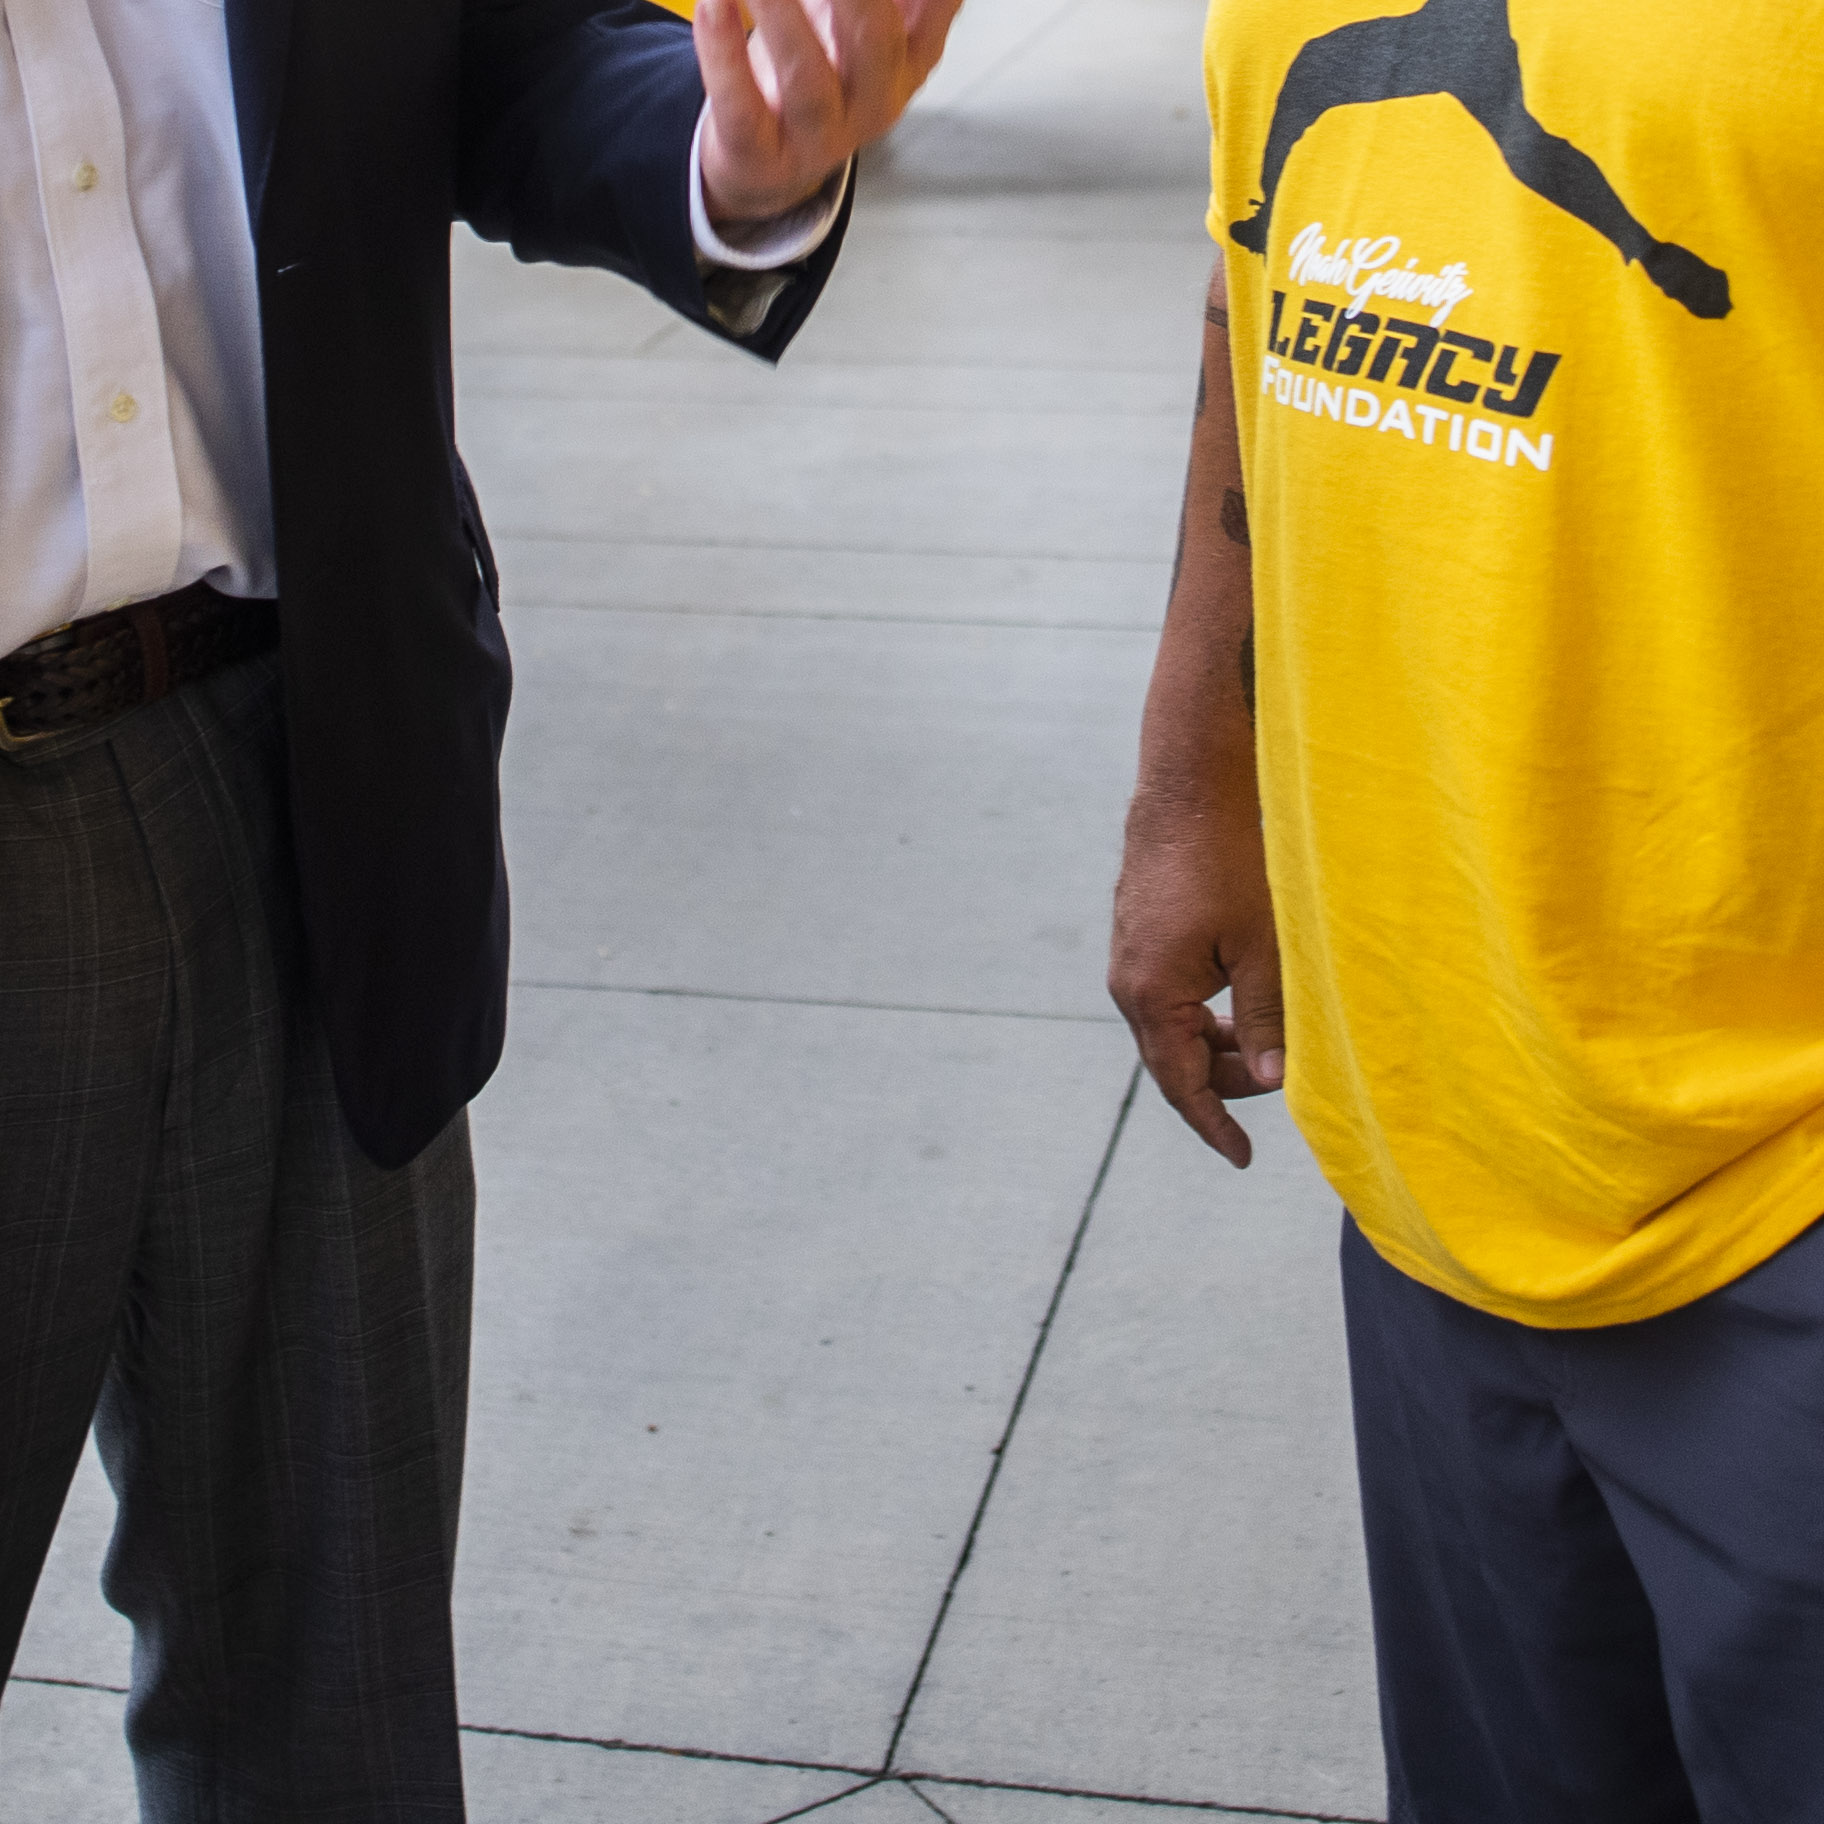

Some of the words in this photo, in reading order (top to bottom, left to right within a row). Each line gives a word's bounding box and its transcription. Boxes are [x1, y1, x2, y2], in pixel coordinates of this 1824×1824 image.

[1288, 222, 1350, 287] Noah
[1261, 354, 1554, 472] FOUNDATION
[1268, 289, 1563, 419] LEGACY
